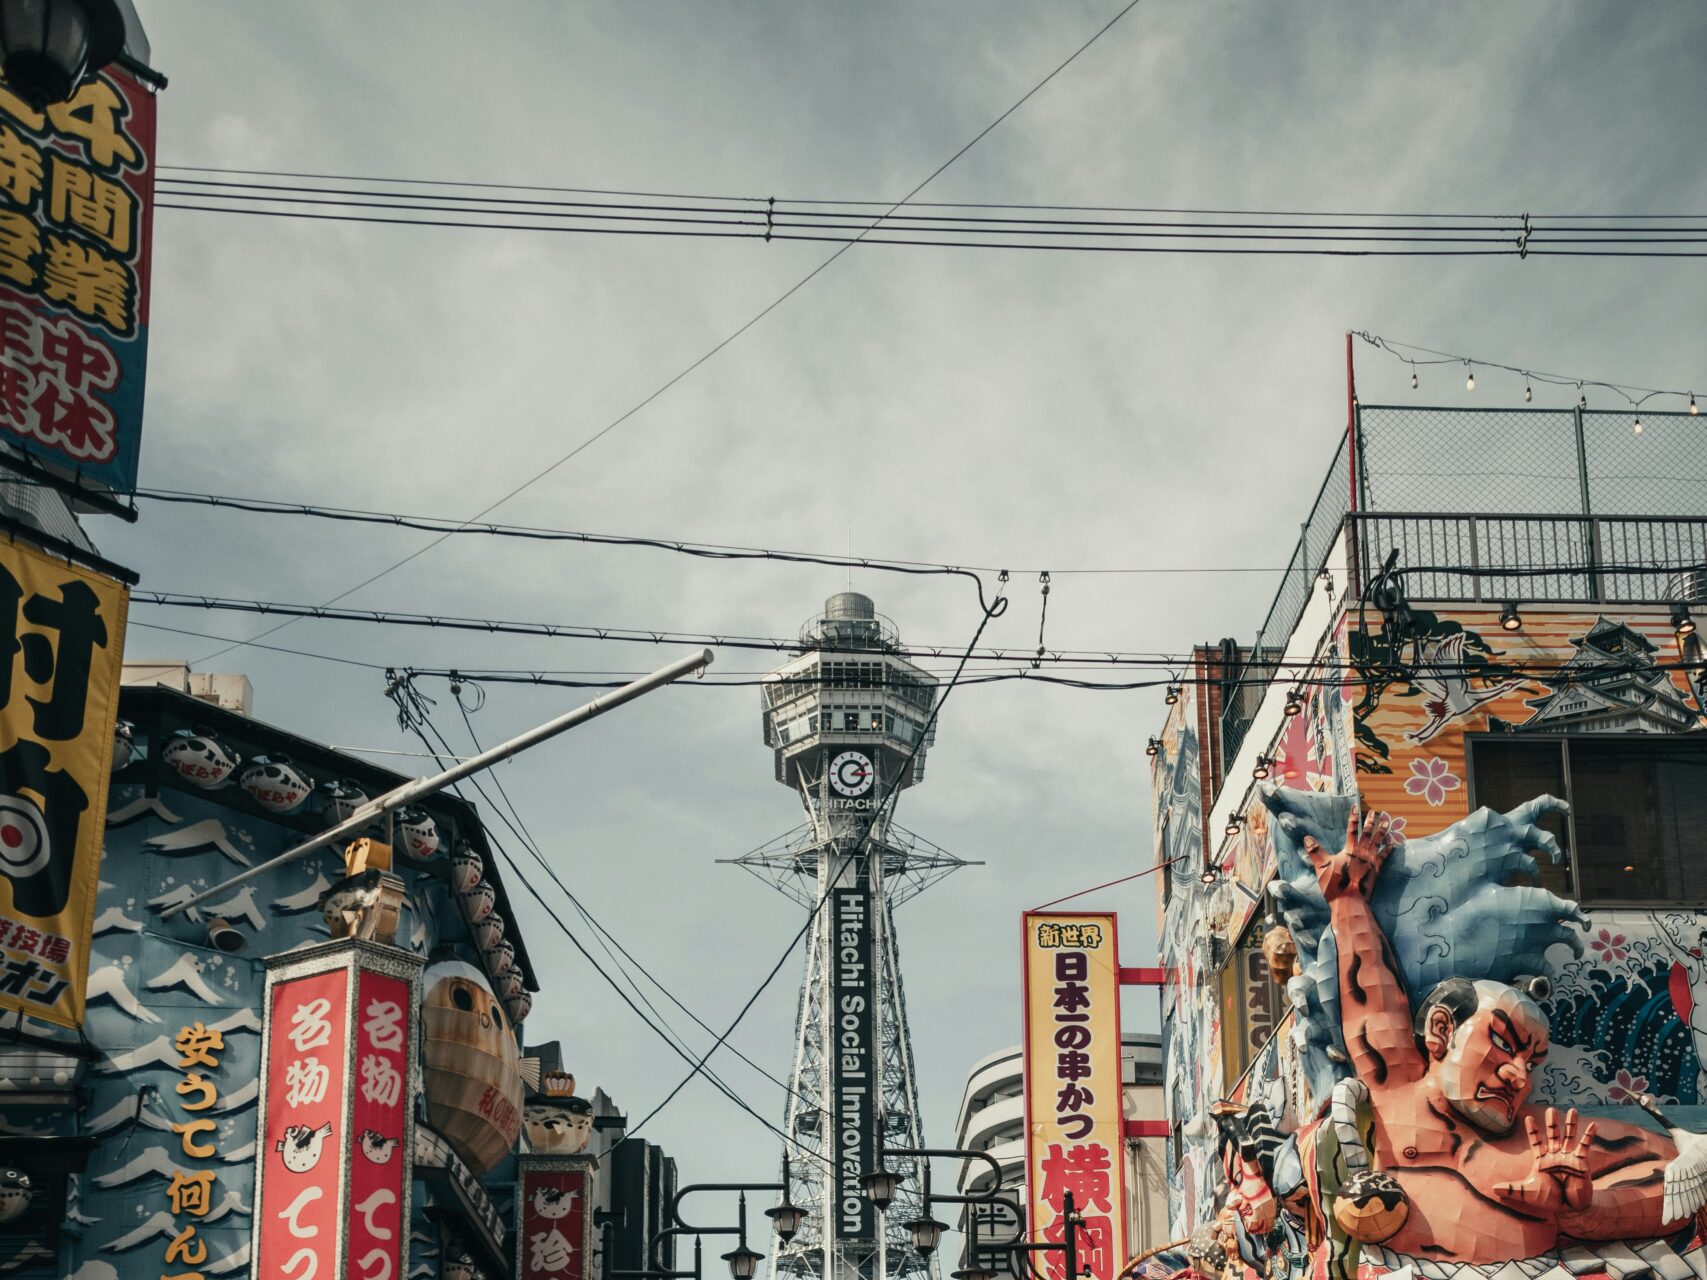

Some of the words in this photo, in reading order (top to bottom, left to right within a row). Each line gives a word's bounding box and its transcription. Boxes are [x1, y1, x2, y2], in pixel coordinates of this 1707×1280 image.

[826, 799, 882, 809] HITACHI
[840, 894, 865, 988] Hitachi
[1038, 924, 1102, 949] 新世界
[284, 997, 332, 1108] 名物
[360, 999, 403, 1108] 名物
[841, 995, 866, 1080] Social
[1053, 951, 1095, 1140] 日本一の串かつ
[842, 1086, 866, 1234] Innovation
